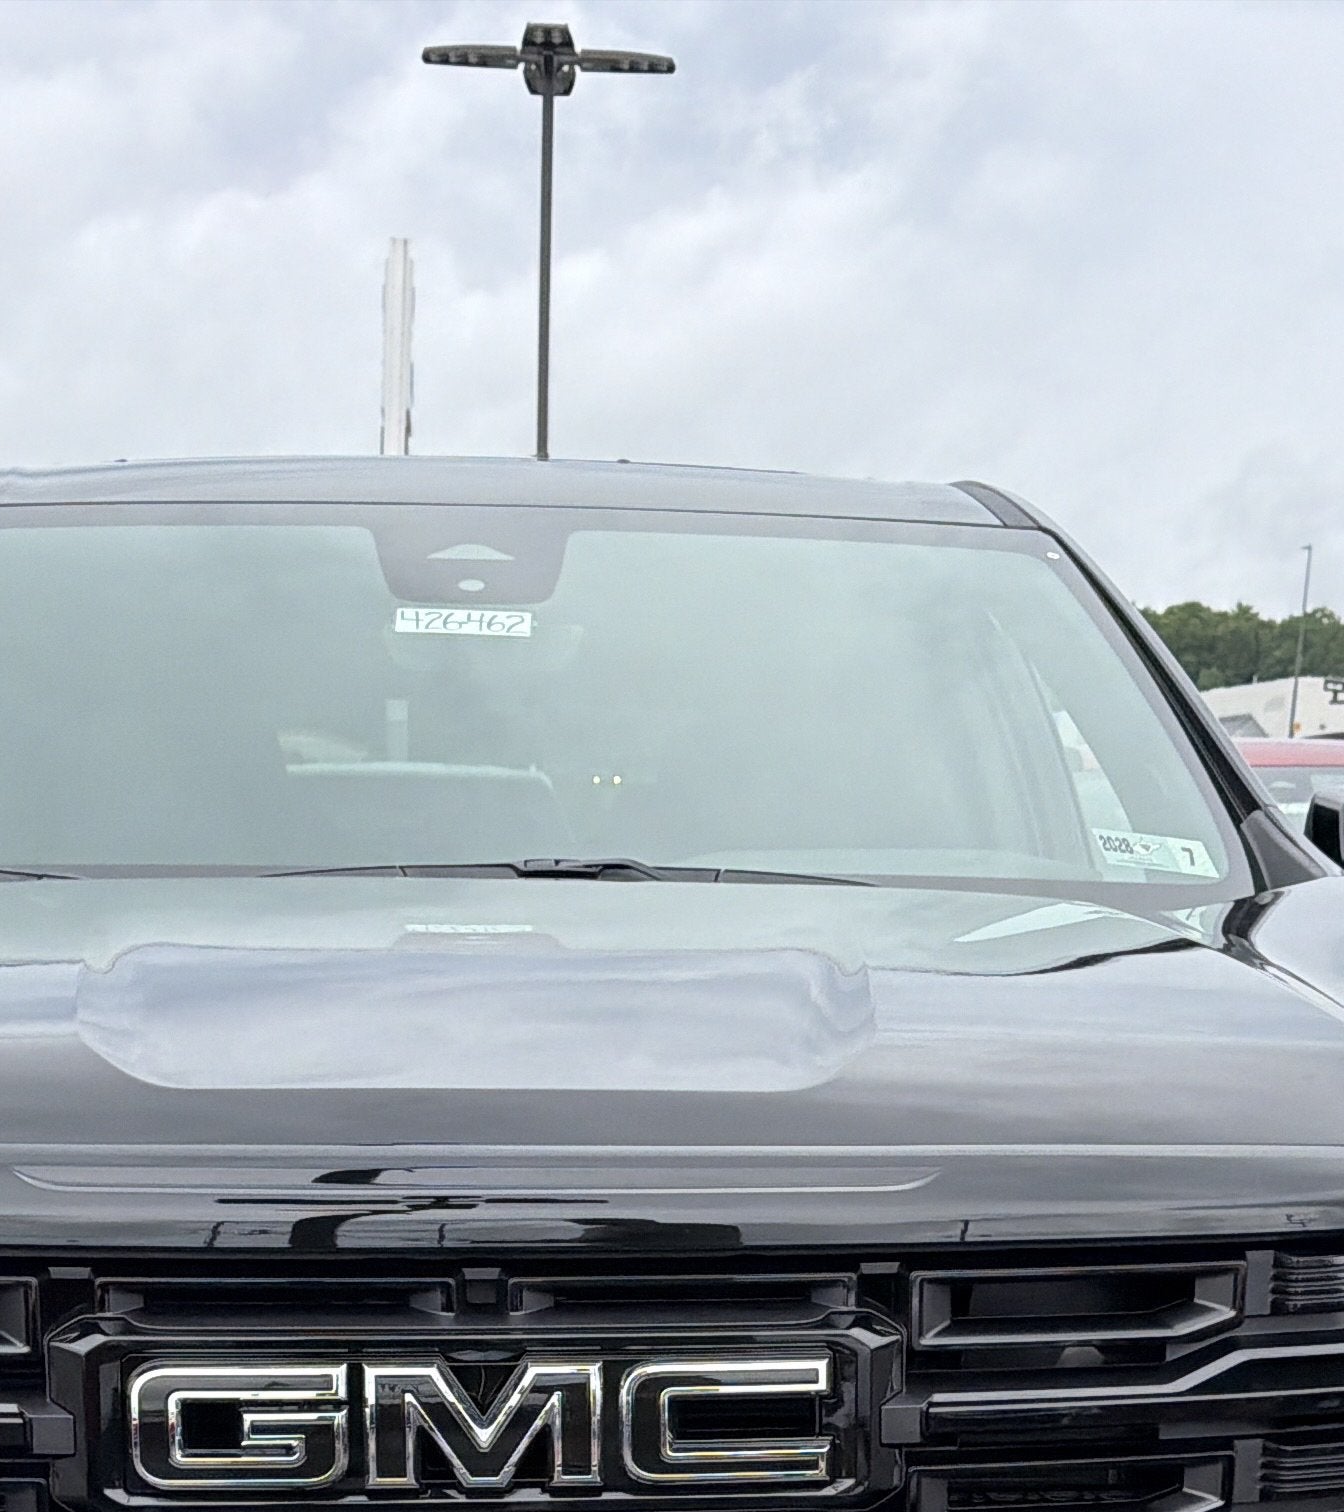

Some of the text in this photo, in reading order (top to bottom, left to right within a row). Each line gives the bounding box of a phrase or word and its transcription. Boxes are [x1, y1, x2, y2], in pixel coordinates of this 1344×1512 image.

[400, 610, 528, 634] 426462
[1098, 834, 1134, 855] 2028
[1181, 846, 1196, 867] 7
[128, 1360, 833, 1492] GMC
